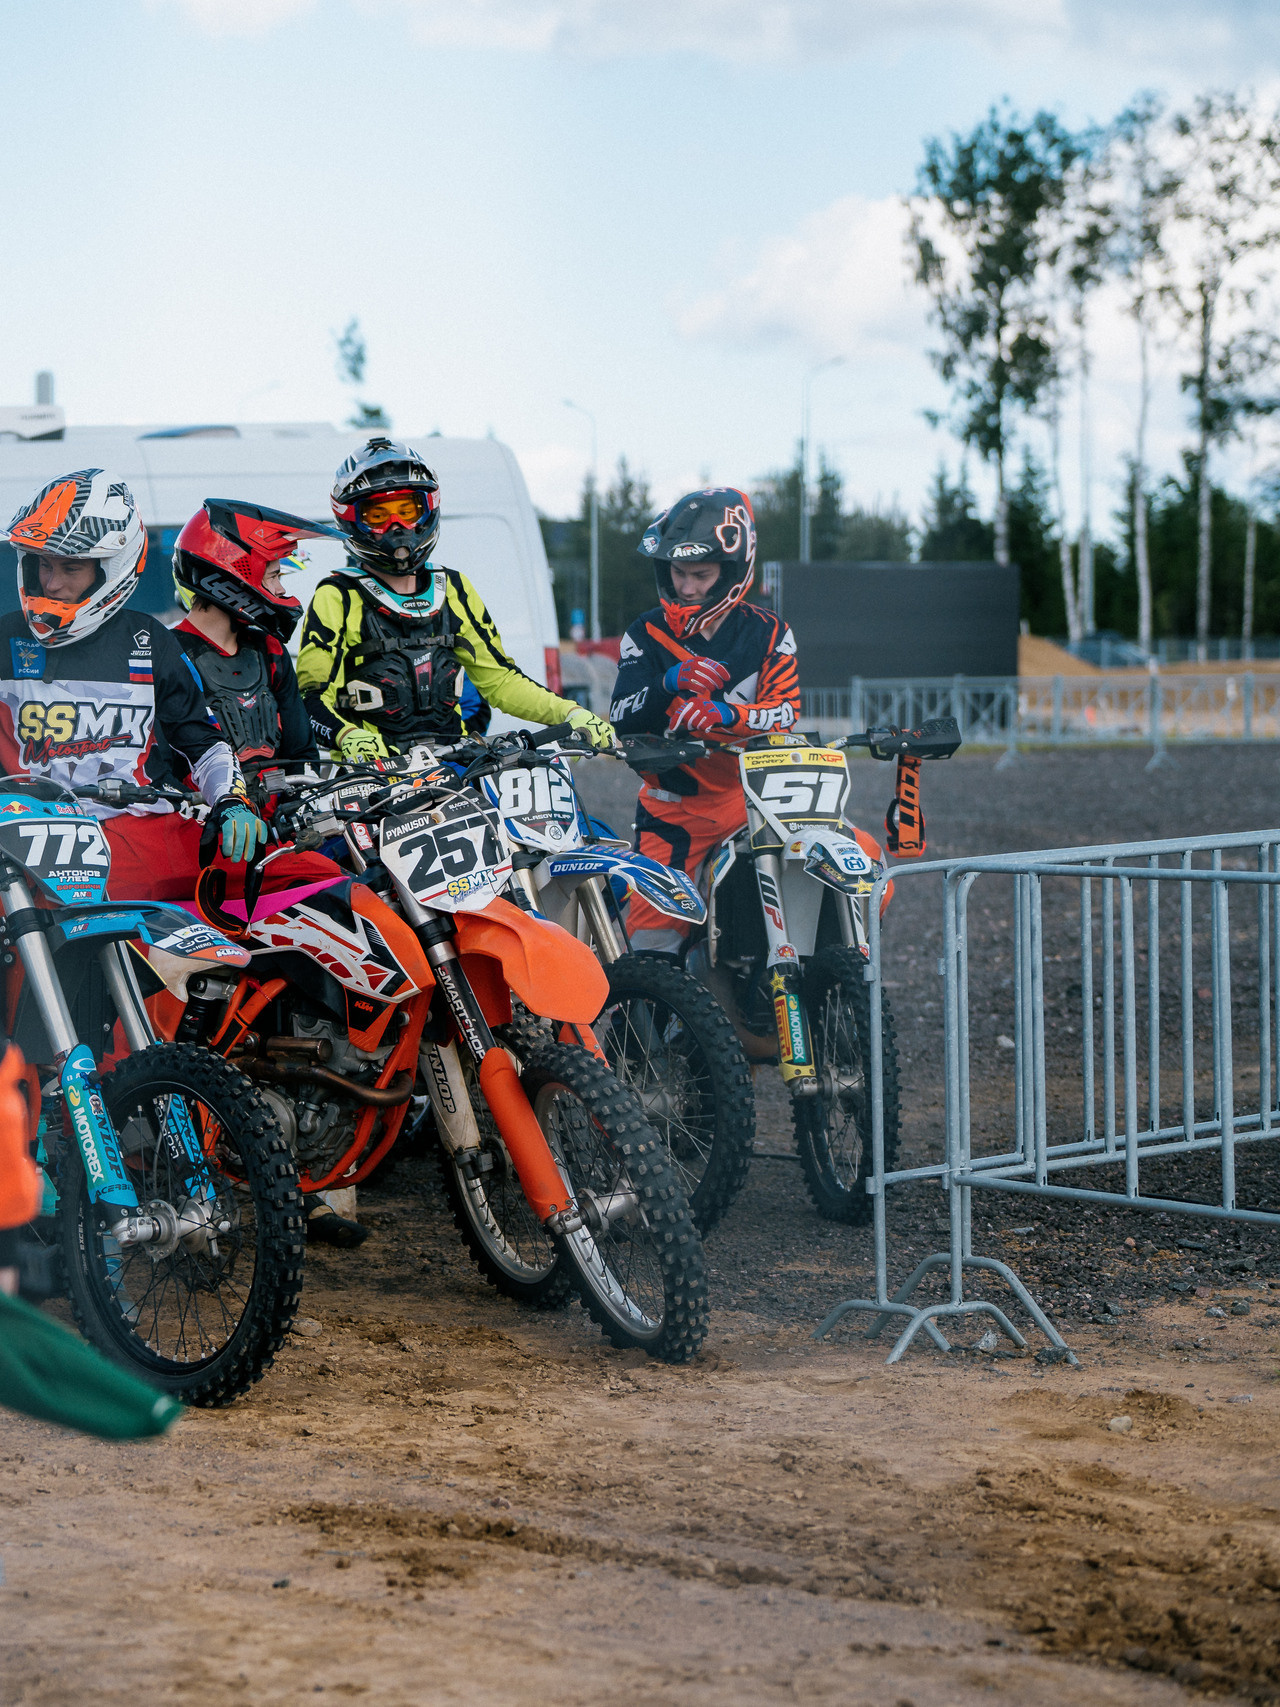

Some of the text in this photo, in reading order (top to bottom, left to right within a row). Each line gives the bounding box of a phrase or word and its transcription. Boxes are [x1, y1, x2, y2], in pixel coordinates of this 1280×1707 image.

[673, 544, 709, 558] Airoh
[609, 686, 649, 723] UFO
[747, 702, 795, 731] UFO
[809, 753, 842, 763] MXGP
[499, 767, 574, 818] 812
[761, 772, 844, 813] 51
[386, 815, 430, 840] PYANUSOV
[19, 824, 109, 867] 772
[398, 811, 503, 894] 257
[48, 869, 101, 878] АНТОНОВ
[553, 863, 604, 872] DUNLOP
[354, 1000, 375, 1013] KTM
[789, 1010, 805, 1060] MOTOREX
[73, 1106, 104, 1184] MOTOREX
